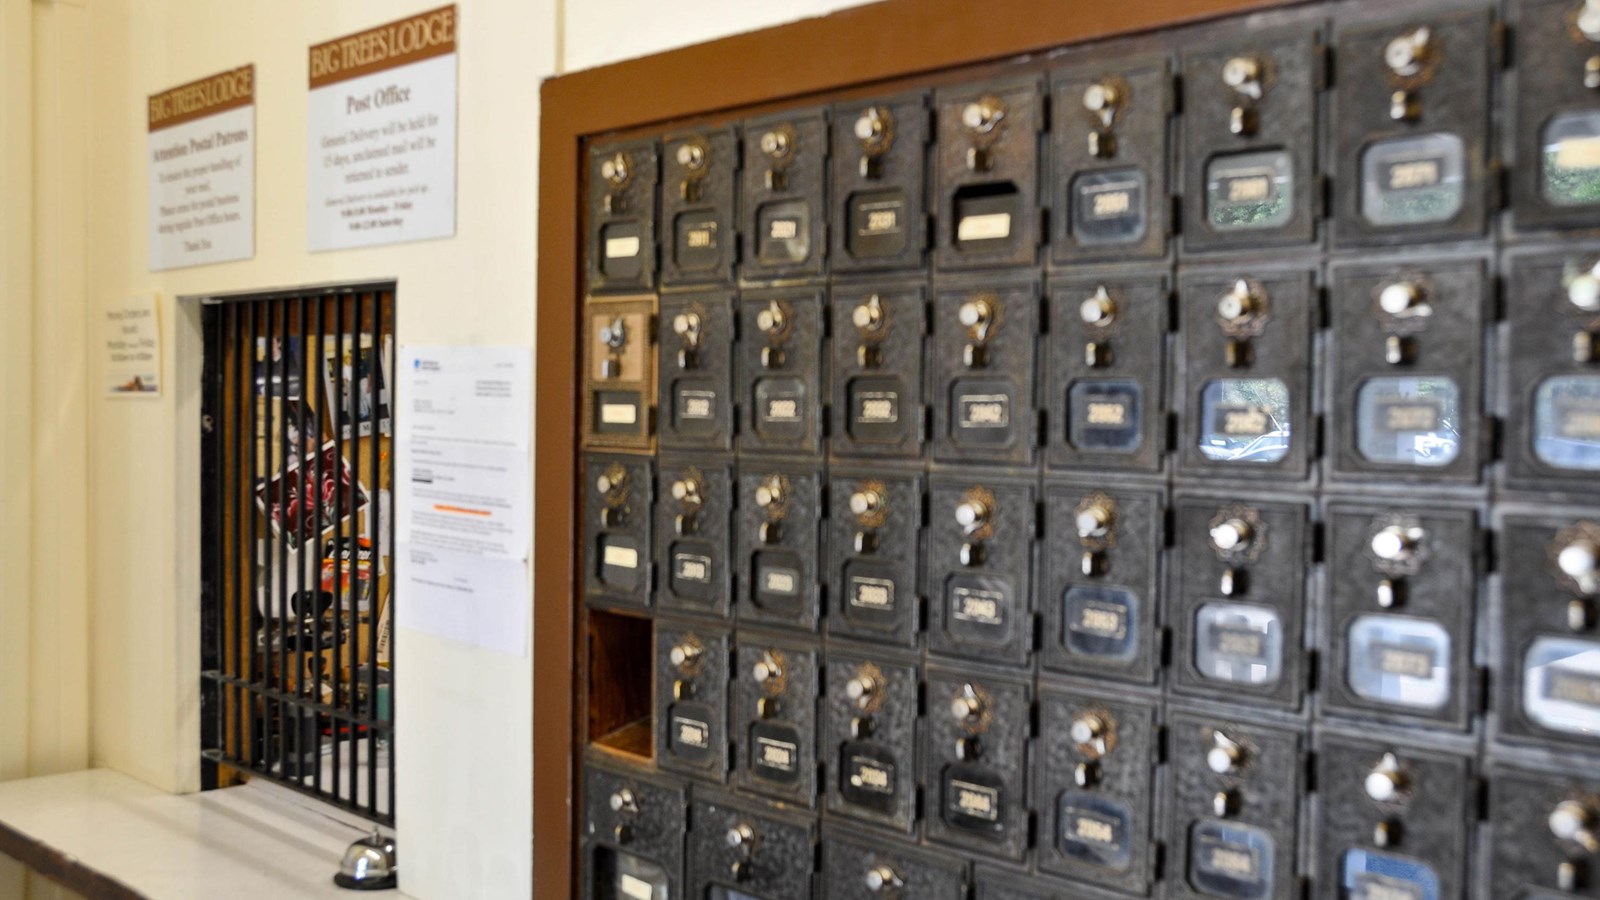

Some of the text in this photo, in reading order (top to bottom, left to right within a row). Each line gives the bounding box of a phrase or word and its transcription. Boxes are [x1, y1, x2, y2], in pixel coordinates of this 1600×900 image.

[310, 9, 454, 78] BIG TREES LODGE
[150, 69, 252, 123] BIG TREES LODGE
[346, 84, 412, 115] Post Office
[153, 129, 249, 162] Attention Postal Patrons
